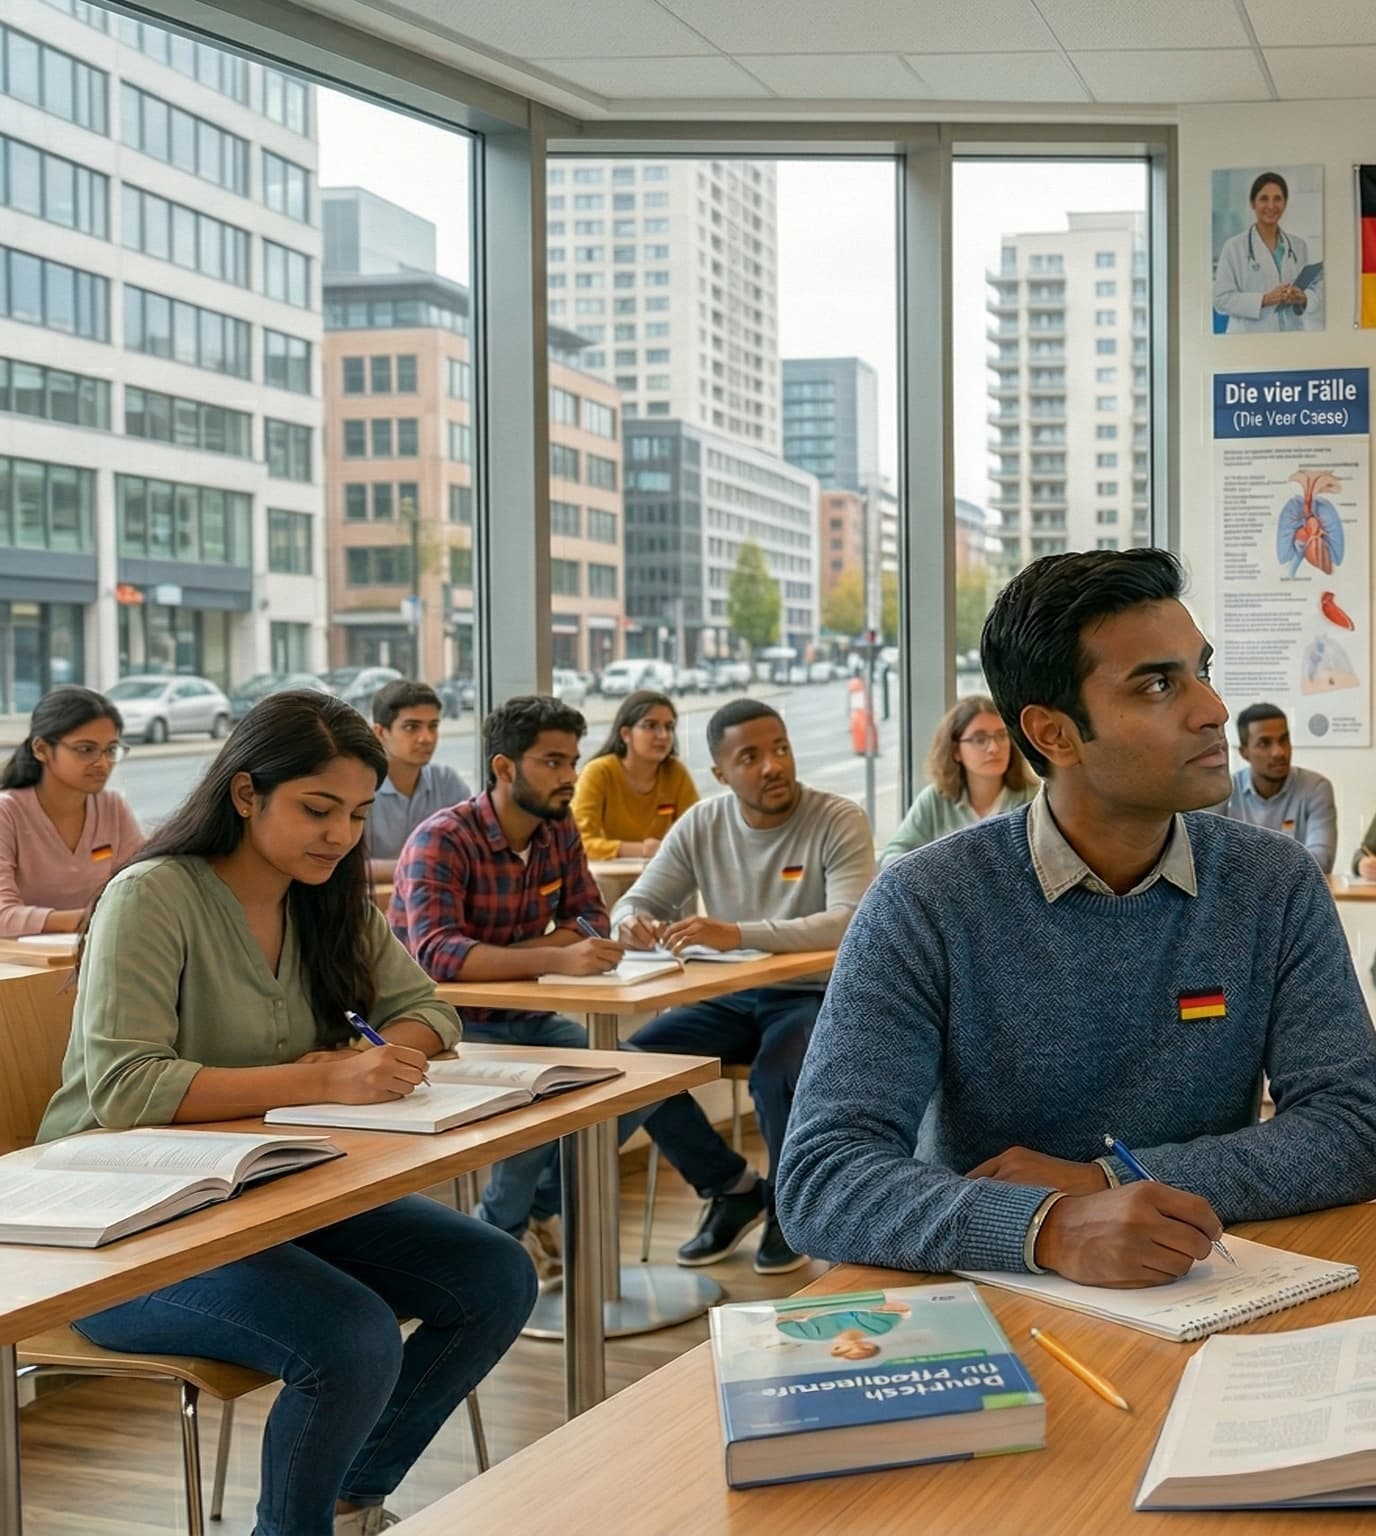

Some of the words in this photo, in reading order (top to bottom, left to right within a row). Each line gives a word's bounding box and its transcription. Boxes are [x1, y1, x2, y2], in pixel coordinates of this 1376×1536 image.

[1225, 382, 1259, 405] Die
[1263, 381, 1302, 403] vier
[1307, 378, 1357, 402] Fälle
